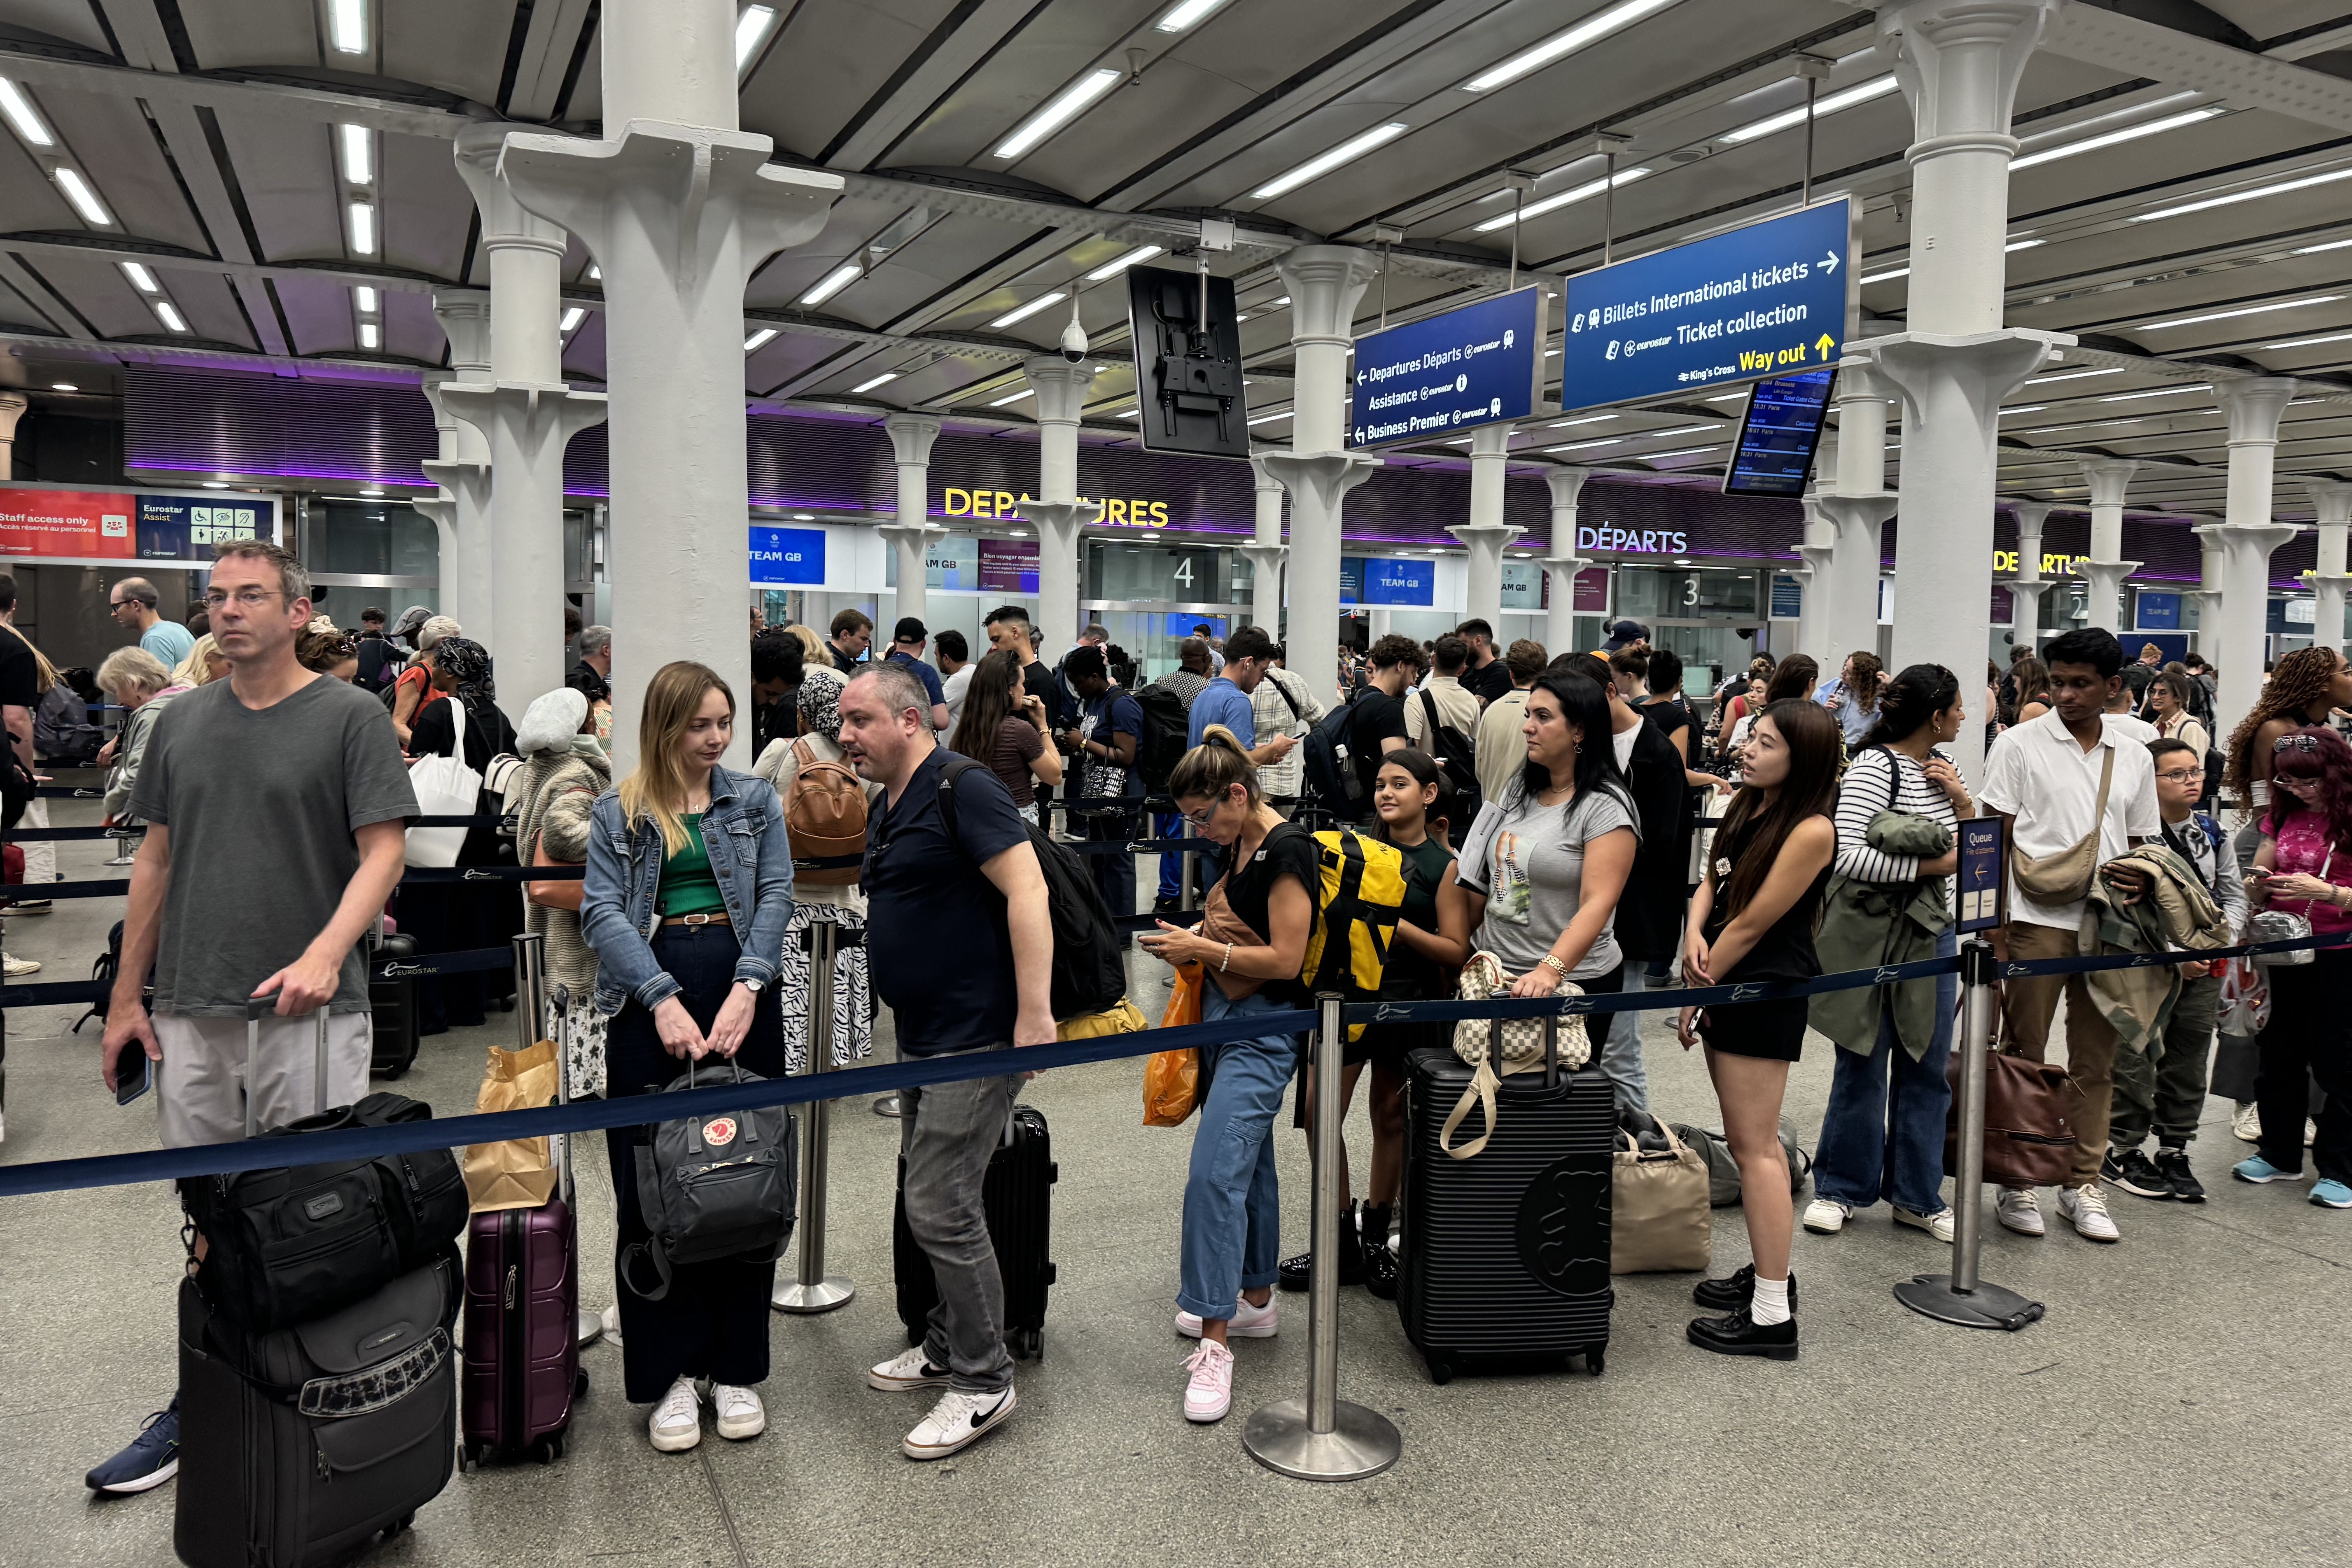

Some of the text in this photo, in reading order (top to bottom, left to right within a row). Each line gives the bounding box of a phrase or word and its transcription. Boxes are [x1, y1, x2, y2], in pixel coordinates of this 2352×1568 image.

[1603, 261, 1808, 325] Billets International tickets
[1636, 303, 1807, 351] eurostar Ticket collection
[1370, 341, 1500, 382] Departures Départs eurostar
[1690, 343, 1806, 381] King's Cross Way out
[1369, 383, 1454, 411] Assistance eurostar
[1368, 406, 1487, 440] Business Premier eurostar
[0, 513, 26, 522] Staff
[66, 517, 89, 526] only
[144, 504, 183, 513] Eurostar
[945, 488, 1169, 528] DEPURES
[1578, 521, 1687, 553] DÉPARTS
[749, 551, 802, 562] TEAM GB
[942, 560, 956, 568] GB
[1174, 557, 1194, 588] 4
[1380, 579, 1405, 587] TEAM
[1683, 579, 1698, 605] 3
[2071, 596, 2088, 619] 2
[1969, 832, 1993, 846] Queue
[397, 967, 437, 975] EUROSTAR
